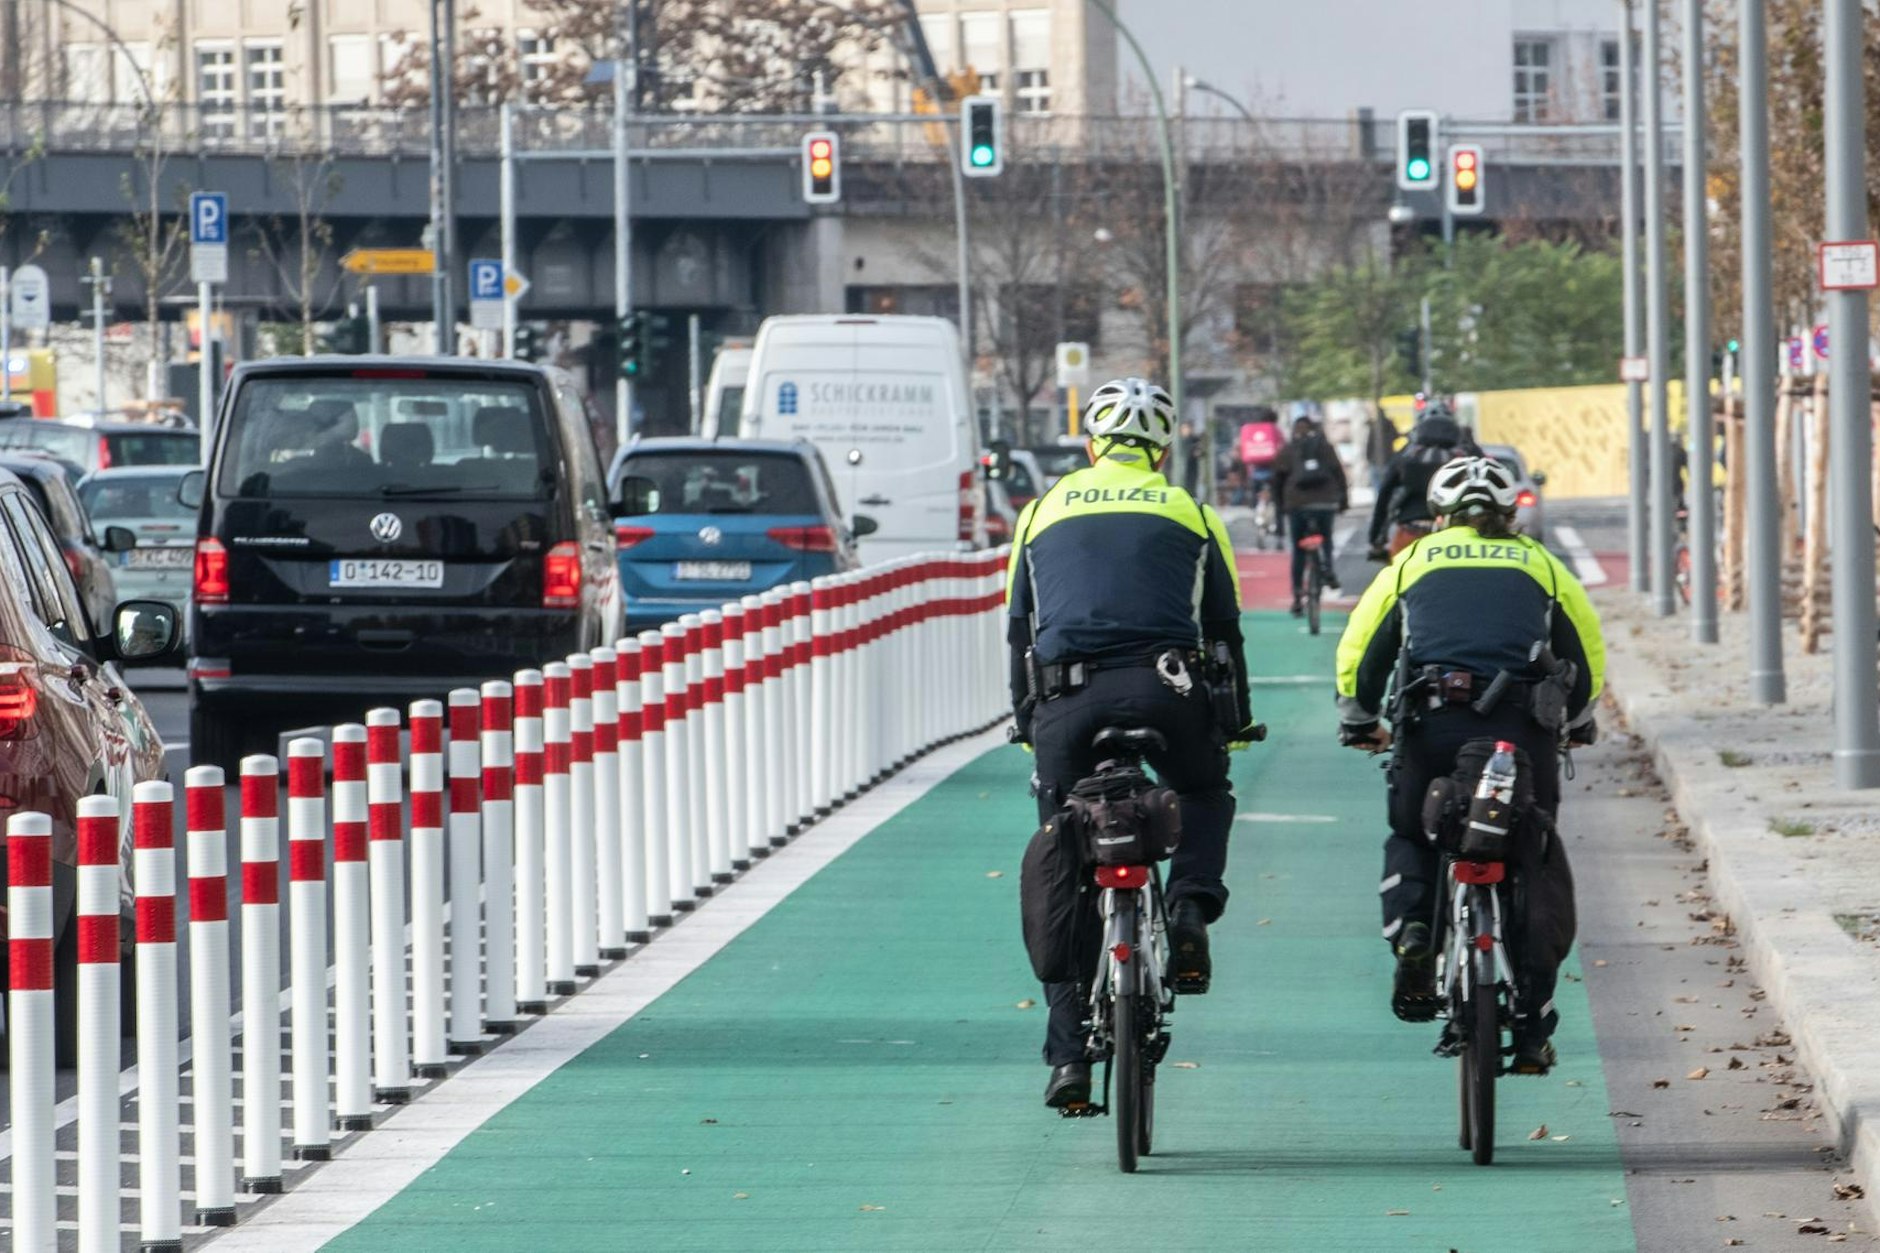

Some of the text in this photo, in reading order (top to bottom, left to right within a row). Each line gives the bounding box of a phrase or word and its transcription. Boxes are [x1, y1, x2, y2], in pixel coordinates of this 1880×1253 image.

[199, 200, 219, 239] P
[477, 265, 498, 295] P
[810, 382, 934, 403] SCHICKRAMM
[1064, 488, 1168, 506] POLIZEI
[1426, 544, 1529, 565] POLIZEI
